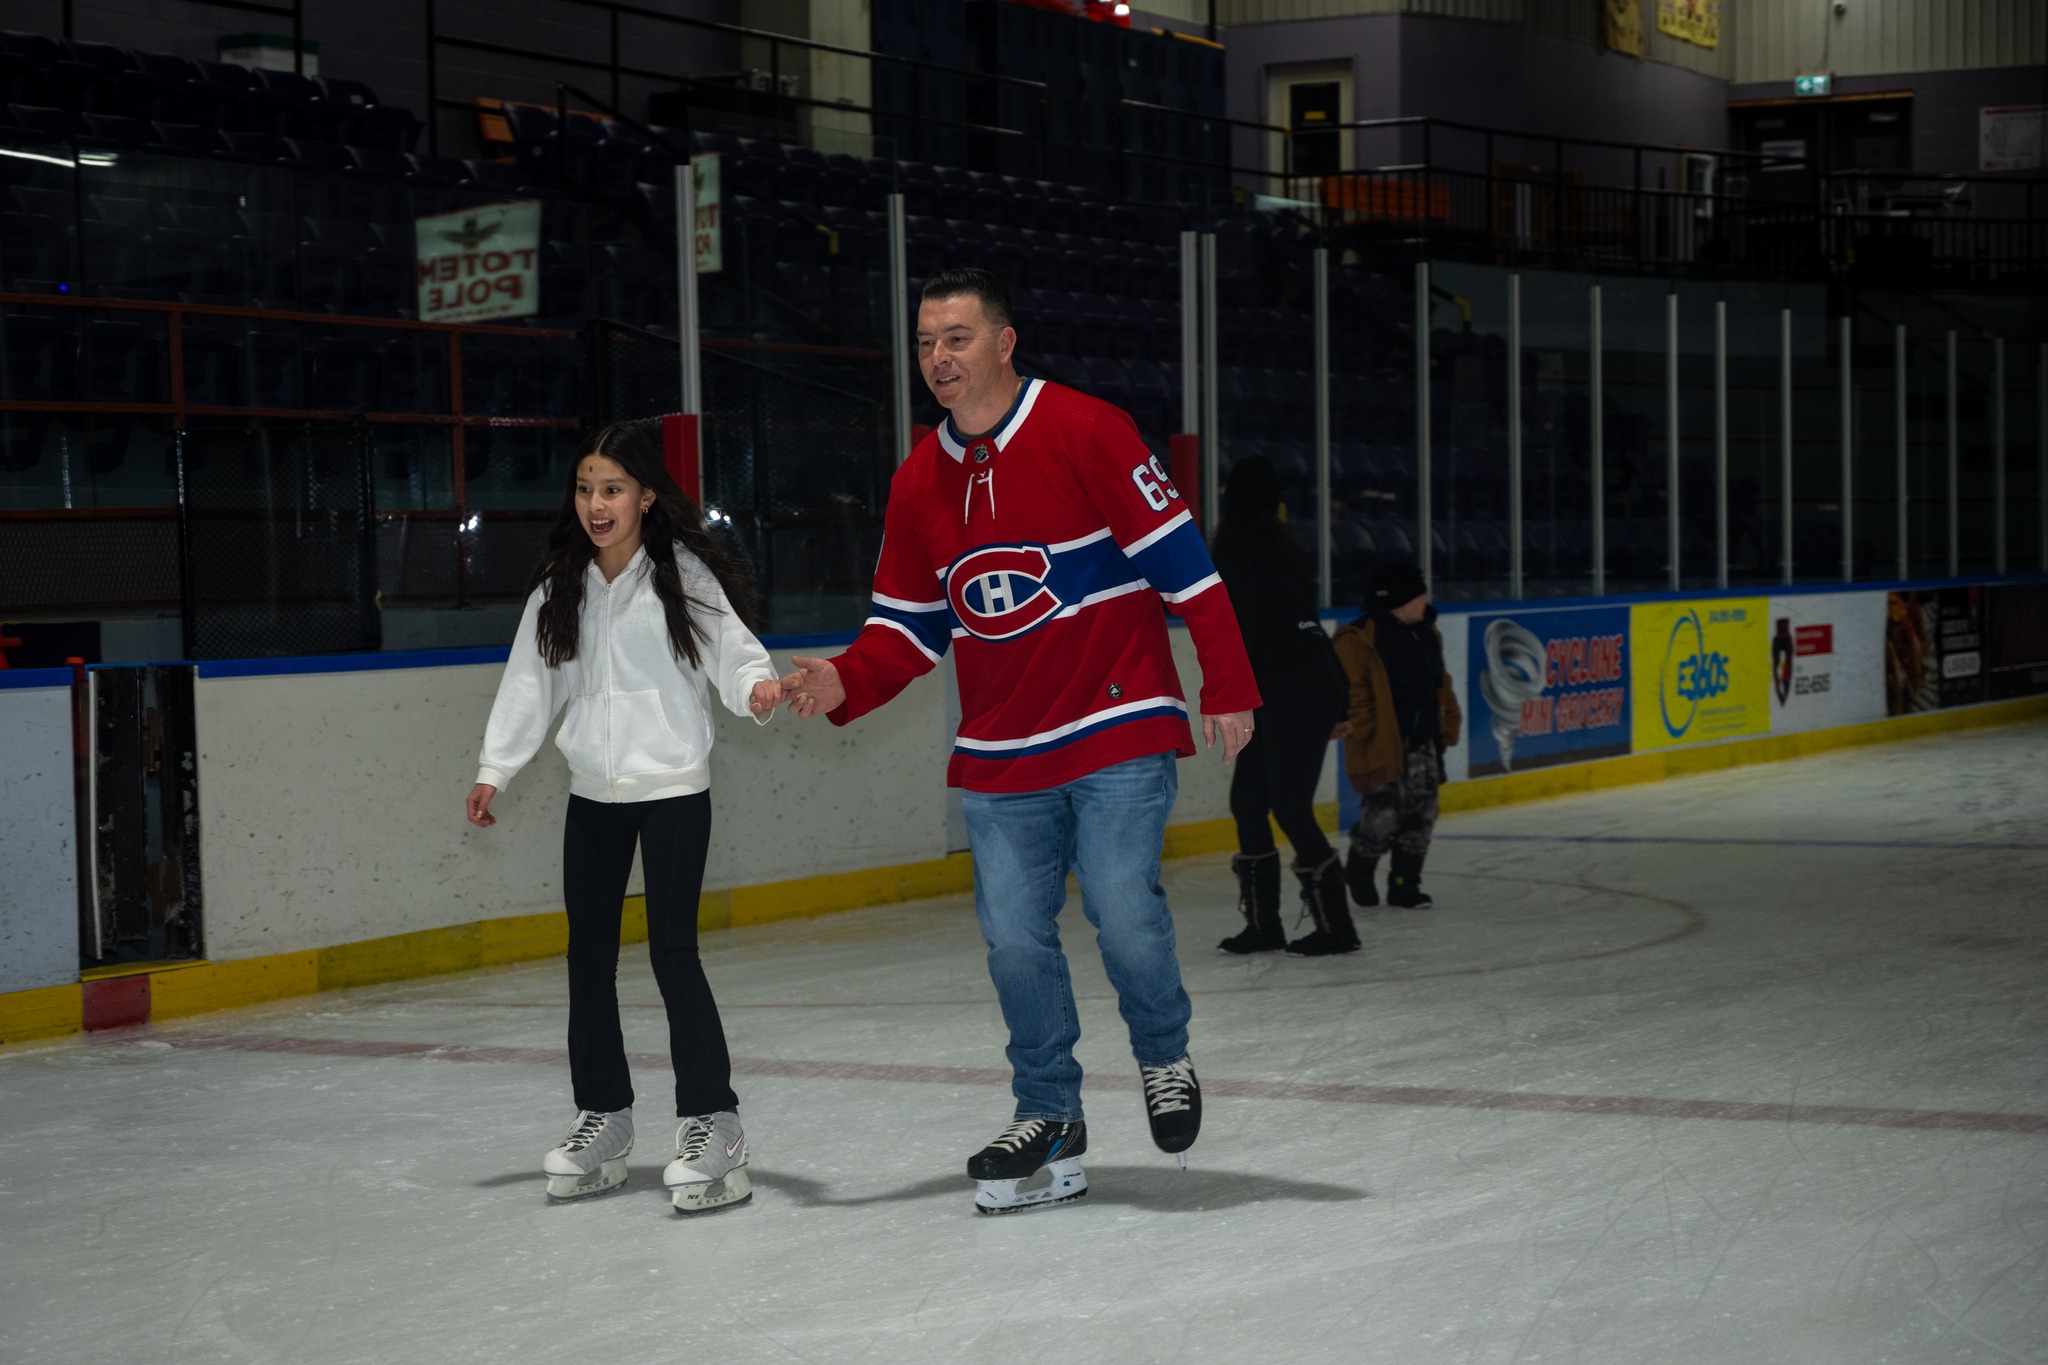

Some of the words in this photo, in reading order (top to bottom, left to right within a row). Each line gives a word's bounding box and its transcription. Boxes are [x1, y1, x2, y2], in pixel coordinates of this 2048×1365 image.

[1132, 454, 1180, 511] 69
[1545, 633, 1624, 688] CYCLONE
[1518, 695, 1555, 737] MINI
[1556, 687, 1624, 733] GROCERY
